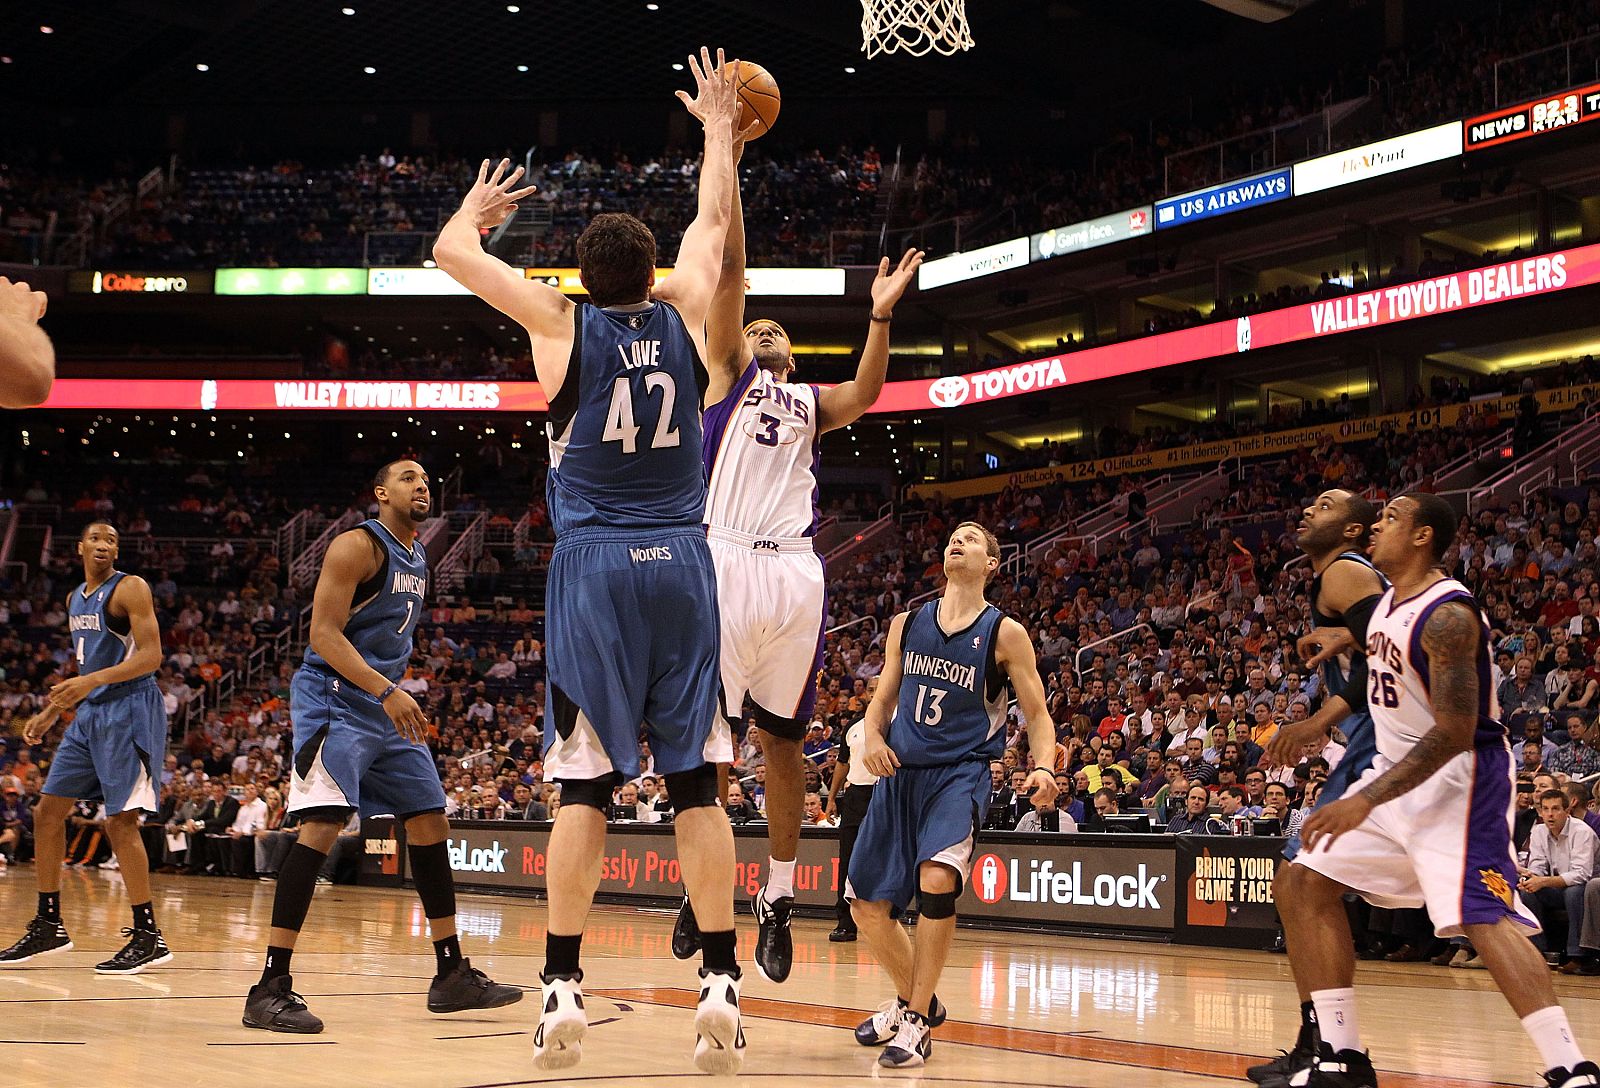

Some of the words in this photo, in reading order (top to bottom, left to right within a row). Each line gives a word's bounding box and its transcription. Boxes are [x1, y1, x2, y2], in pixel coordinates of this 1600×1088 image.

[1587, 94, 1600, 111] T
[1472, 114, 1526, 142] NEWS
[1533, 112, 1579, 133] KTAR
[1207, 177, 1286, 211] AIRWAYS
[1057, 231, 1088, 248] Game
[969, 253, 1014, 272] verizon
[1311, 292, 1380, 334] VALLEY
[1385, 276, 1462, 320] TOYOTA
[1468, 254, 1567, 304] DEALERS
[618, 341, 661, 370] LOVE
[971, 359, 1067, 399] TOYOTA
[274, 382, 342, 407] VALLEY
[343, 382, 412, 407] TOYOTA
[415, 383, 500, 408] DEALERS
[602, 372, 681, 454] 42
[755, 412, 782, 447] 3
[1018, 469, 1056, 485] LifeLock
[1071, 461, 1096, 477] 124
[1112, 455, 1152, 471] LifeLock
[1192, 444, 1230, 459] Identity
[1232, 438, 1261, 451] Theft
[629, 546, 672, 563] WOLVES
[753, 540, 780, 552] PHX
[398, 600, 414, 634] 7
[76, 636, 85, 665] 4
[904, 651, 977, 693] MINNESOTA
[1371, 668, 1400, 709] 26
[914, 684, 949, 726] 13
[1196, 857, 1235, 879] BRING
[1239, 858, 1274, 880] YOUR
[1196, 879, 1234, 901] GAME
[1240, 881, 1274, 903] FACE
